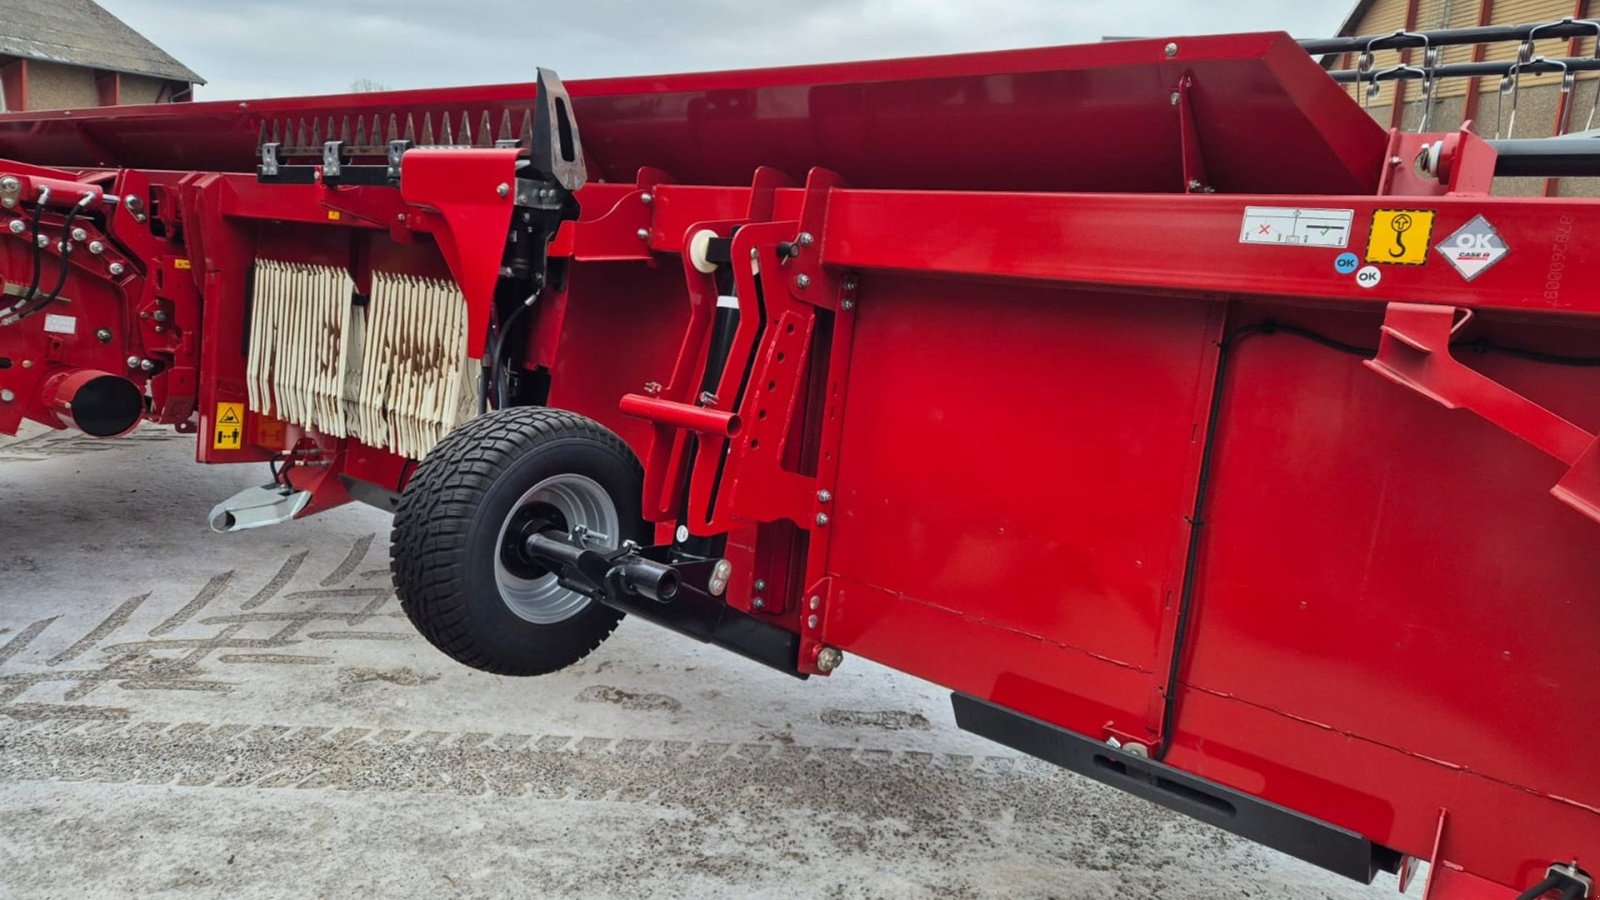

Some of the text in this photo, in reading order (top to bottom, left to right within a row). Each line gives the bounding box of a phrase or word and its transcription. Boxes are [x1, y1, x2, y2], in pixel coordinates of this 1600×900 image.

[1456, 233, 1495, 249] OK
[1336, 258, 1355, 268] OK
[1358, 272, 1377, 282] OK
